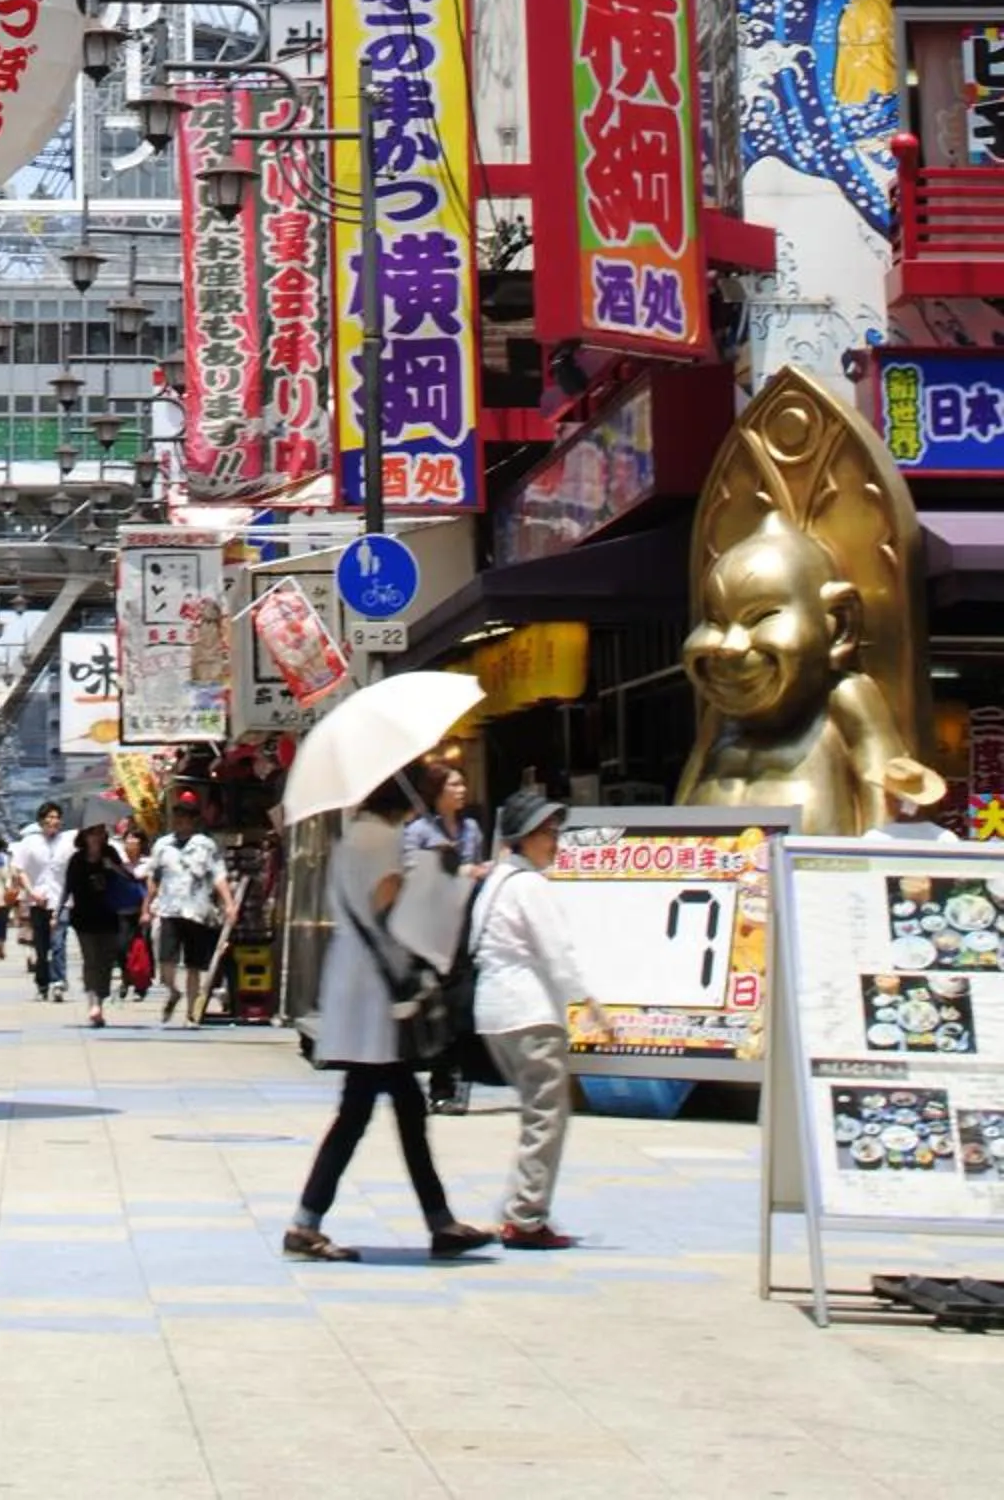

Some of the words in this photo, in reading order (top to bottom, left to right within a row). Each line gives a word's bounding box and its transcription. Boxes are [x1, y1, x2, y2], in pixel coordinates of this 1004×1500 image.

[596, 262, 685, 336] 酒処
[348, 230, 463, 445] 横綱
[69, 643, 121, 699] 味
[666, 889, 720, 988] 7
[734, 975, 757, 1005] 日
